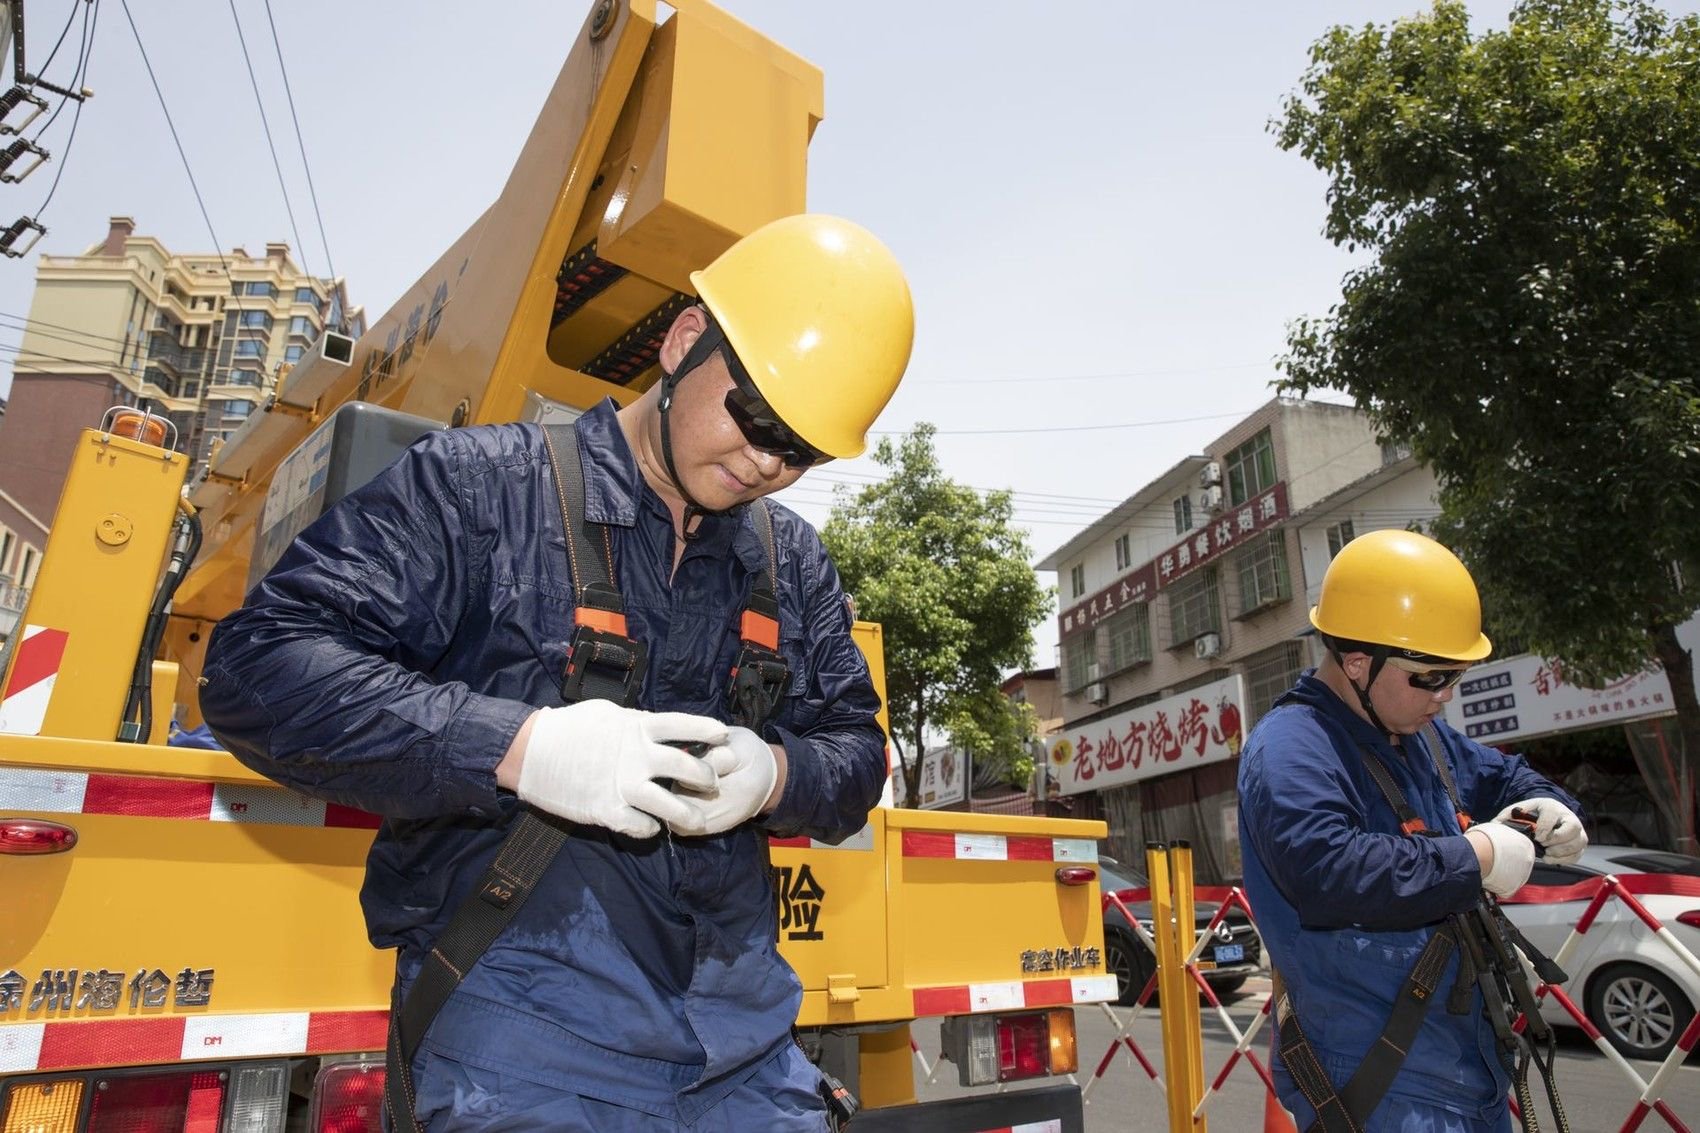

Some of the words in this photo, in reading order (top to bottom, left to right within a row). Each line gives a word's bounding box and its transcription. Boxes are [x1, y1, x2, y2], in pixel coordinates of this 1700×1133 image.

[1073, 698, 1210, 782] 老地方烧烤
[770, 863, 825, 943] 险
[1021, 945, 1101, 973] 高空作业车
[204, 1036, 222, 1046] DM
